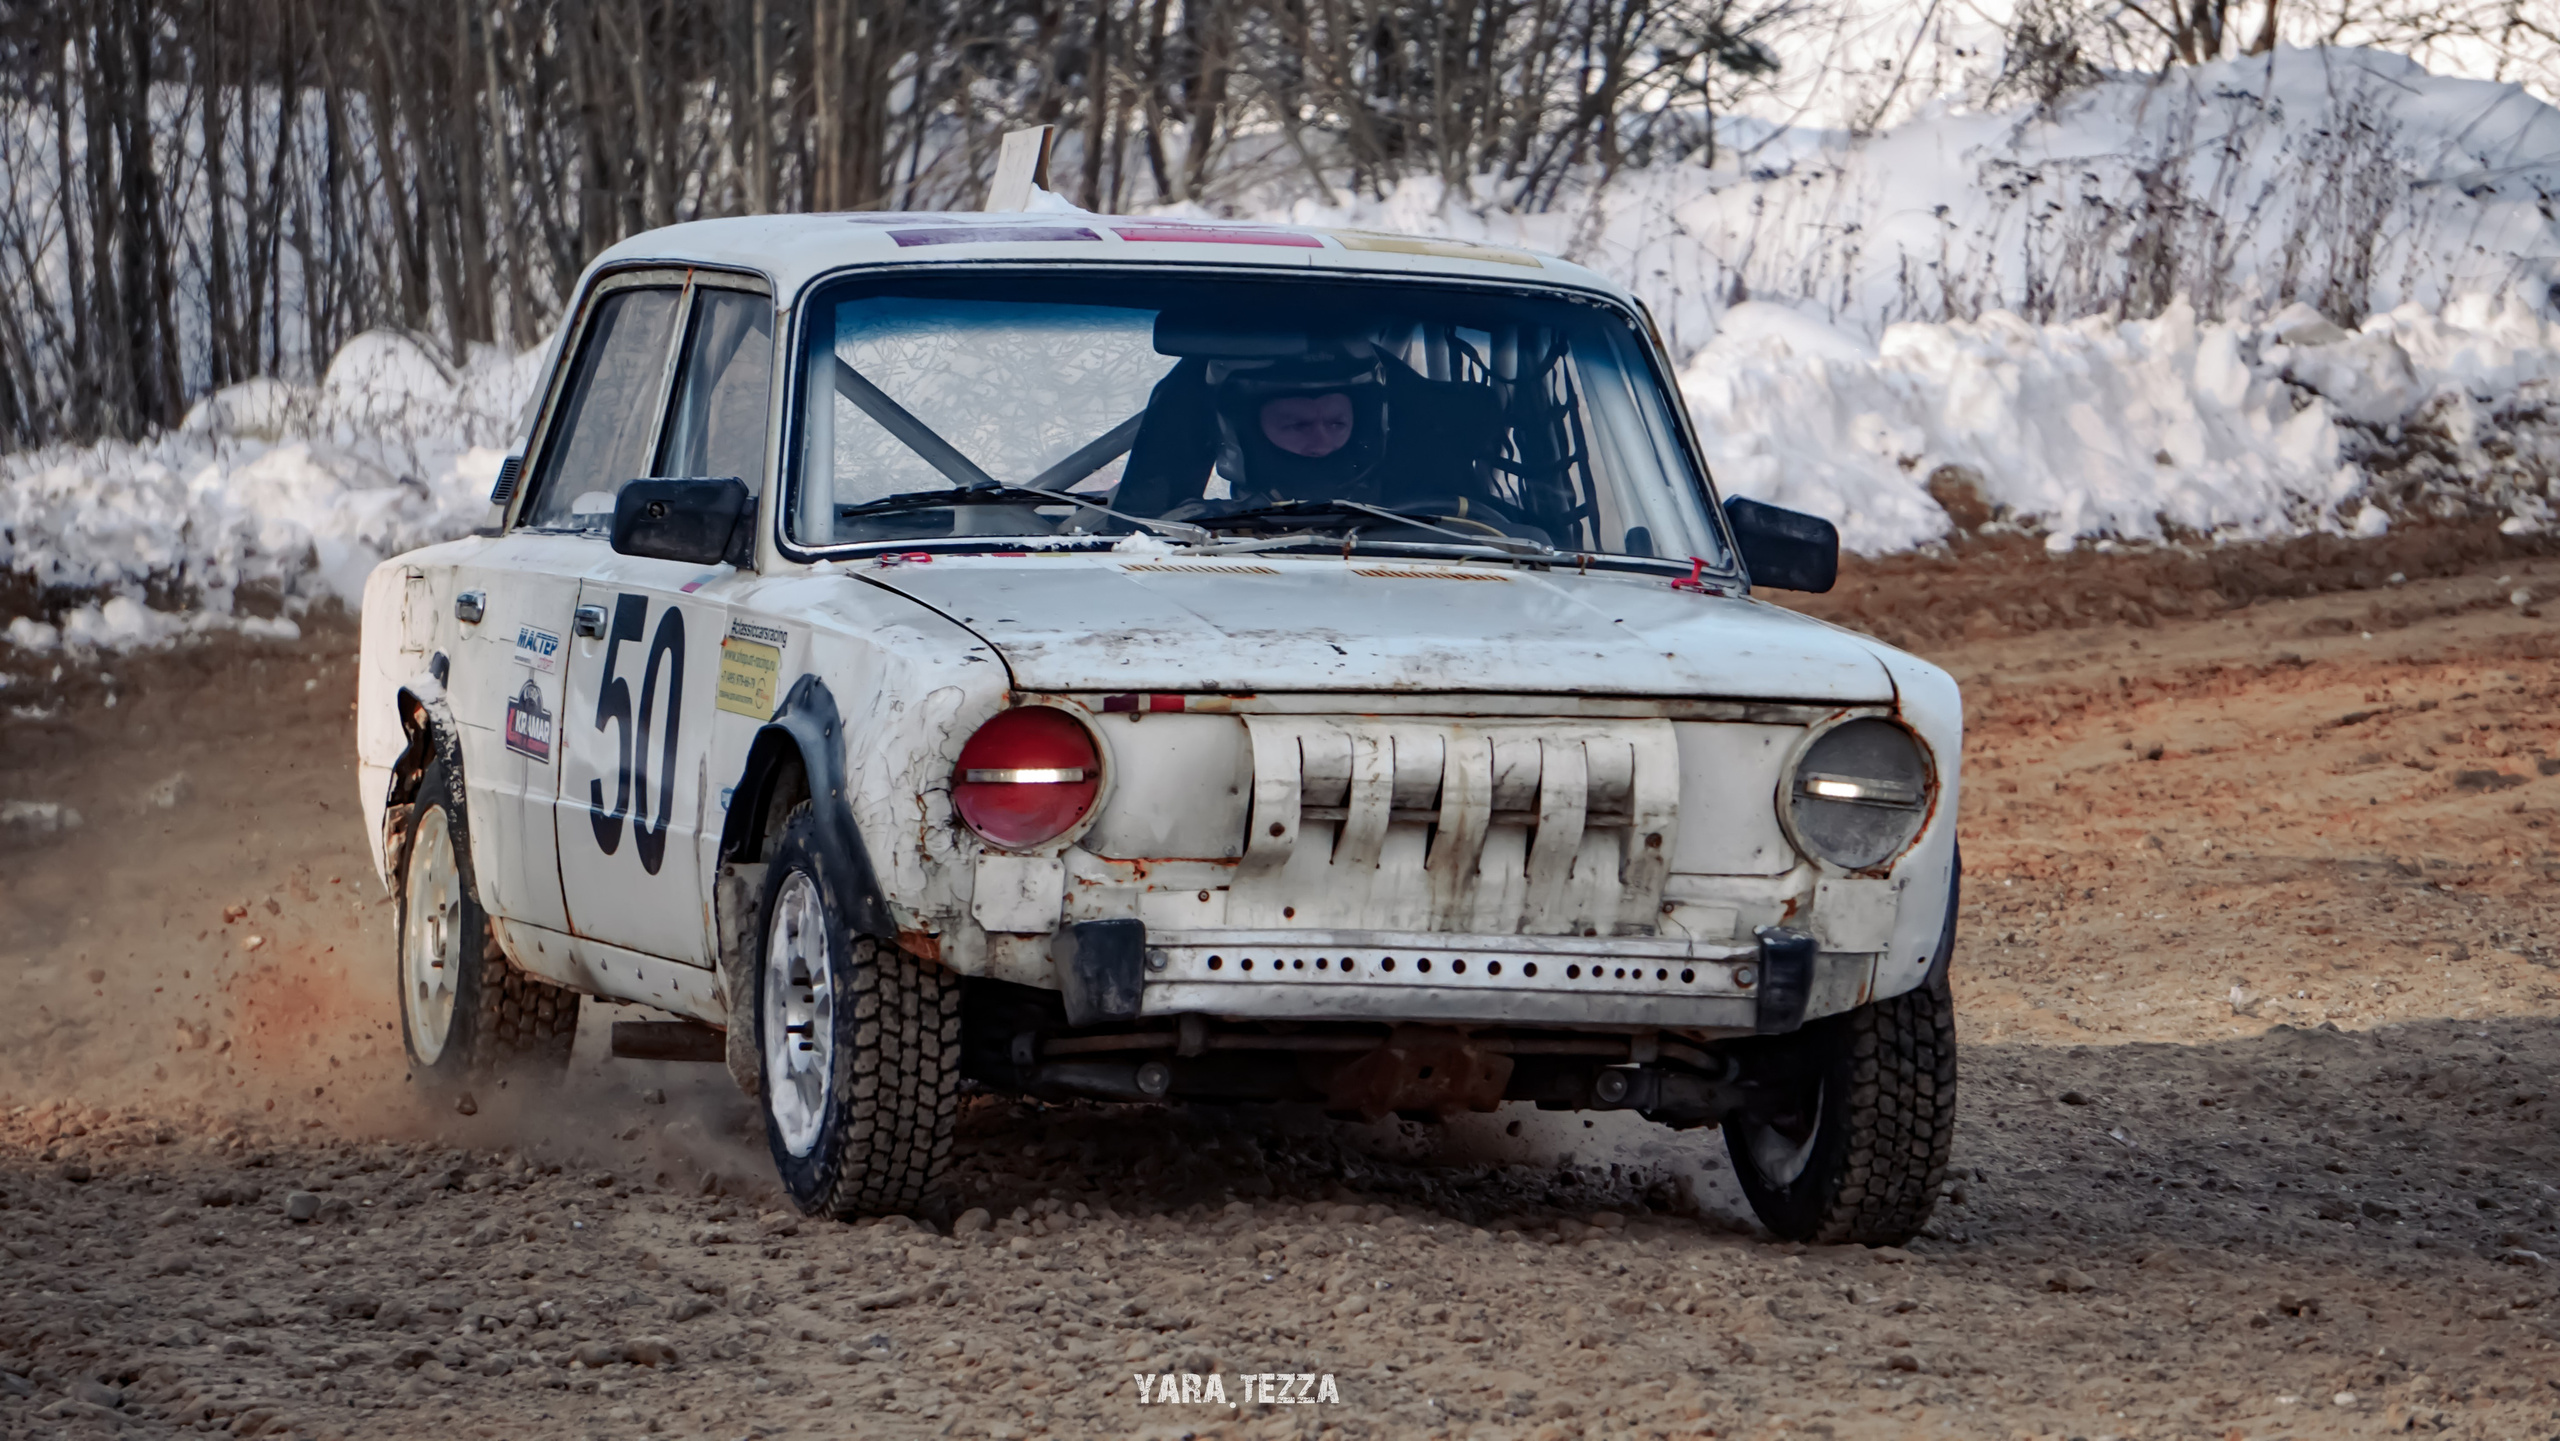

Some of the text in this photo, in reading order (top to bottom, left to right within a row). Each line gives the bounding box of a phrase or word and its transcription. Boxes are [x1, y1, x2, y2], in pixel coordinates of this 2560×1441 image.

[516, 627, 559, 656] МАСТЕР
[731, 617, 788, 648] #classiccarsracing
[514, 709, 550, 744] KRAMAR
[590, 592, 686, 876] 50
